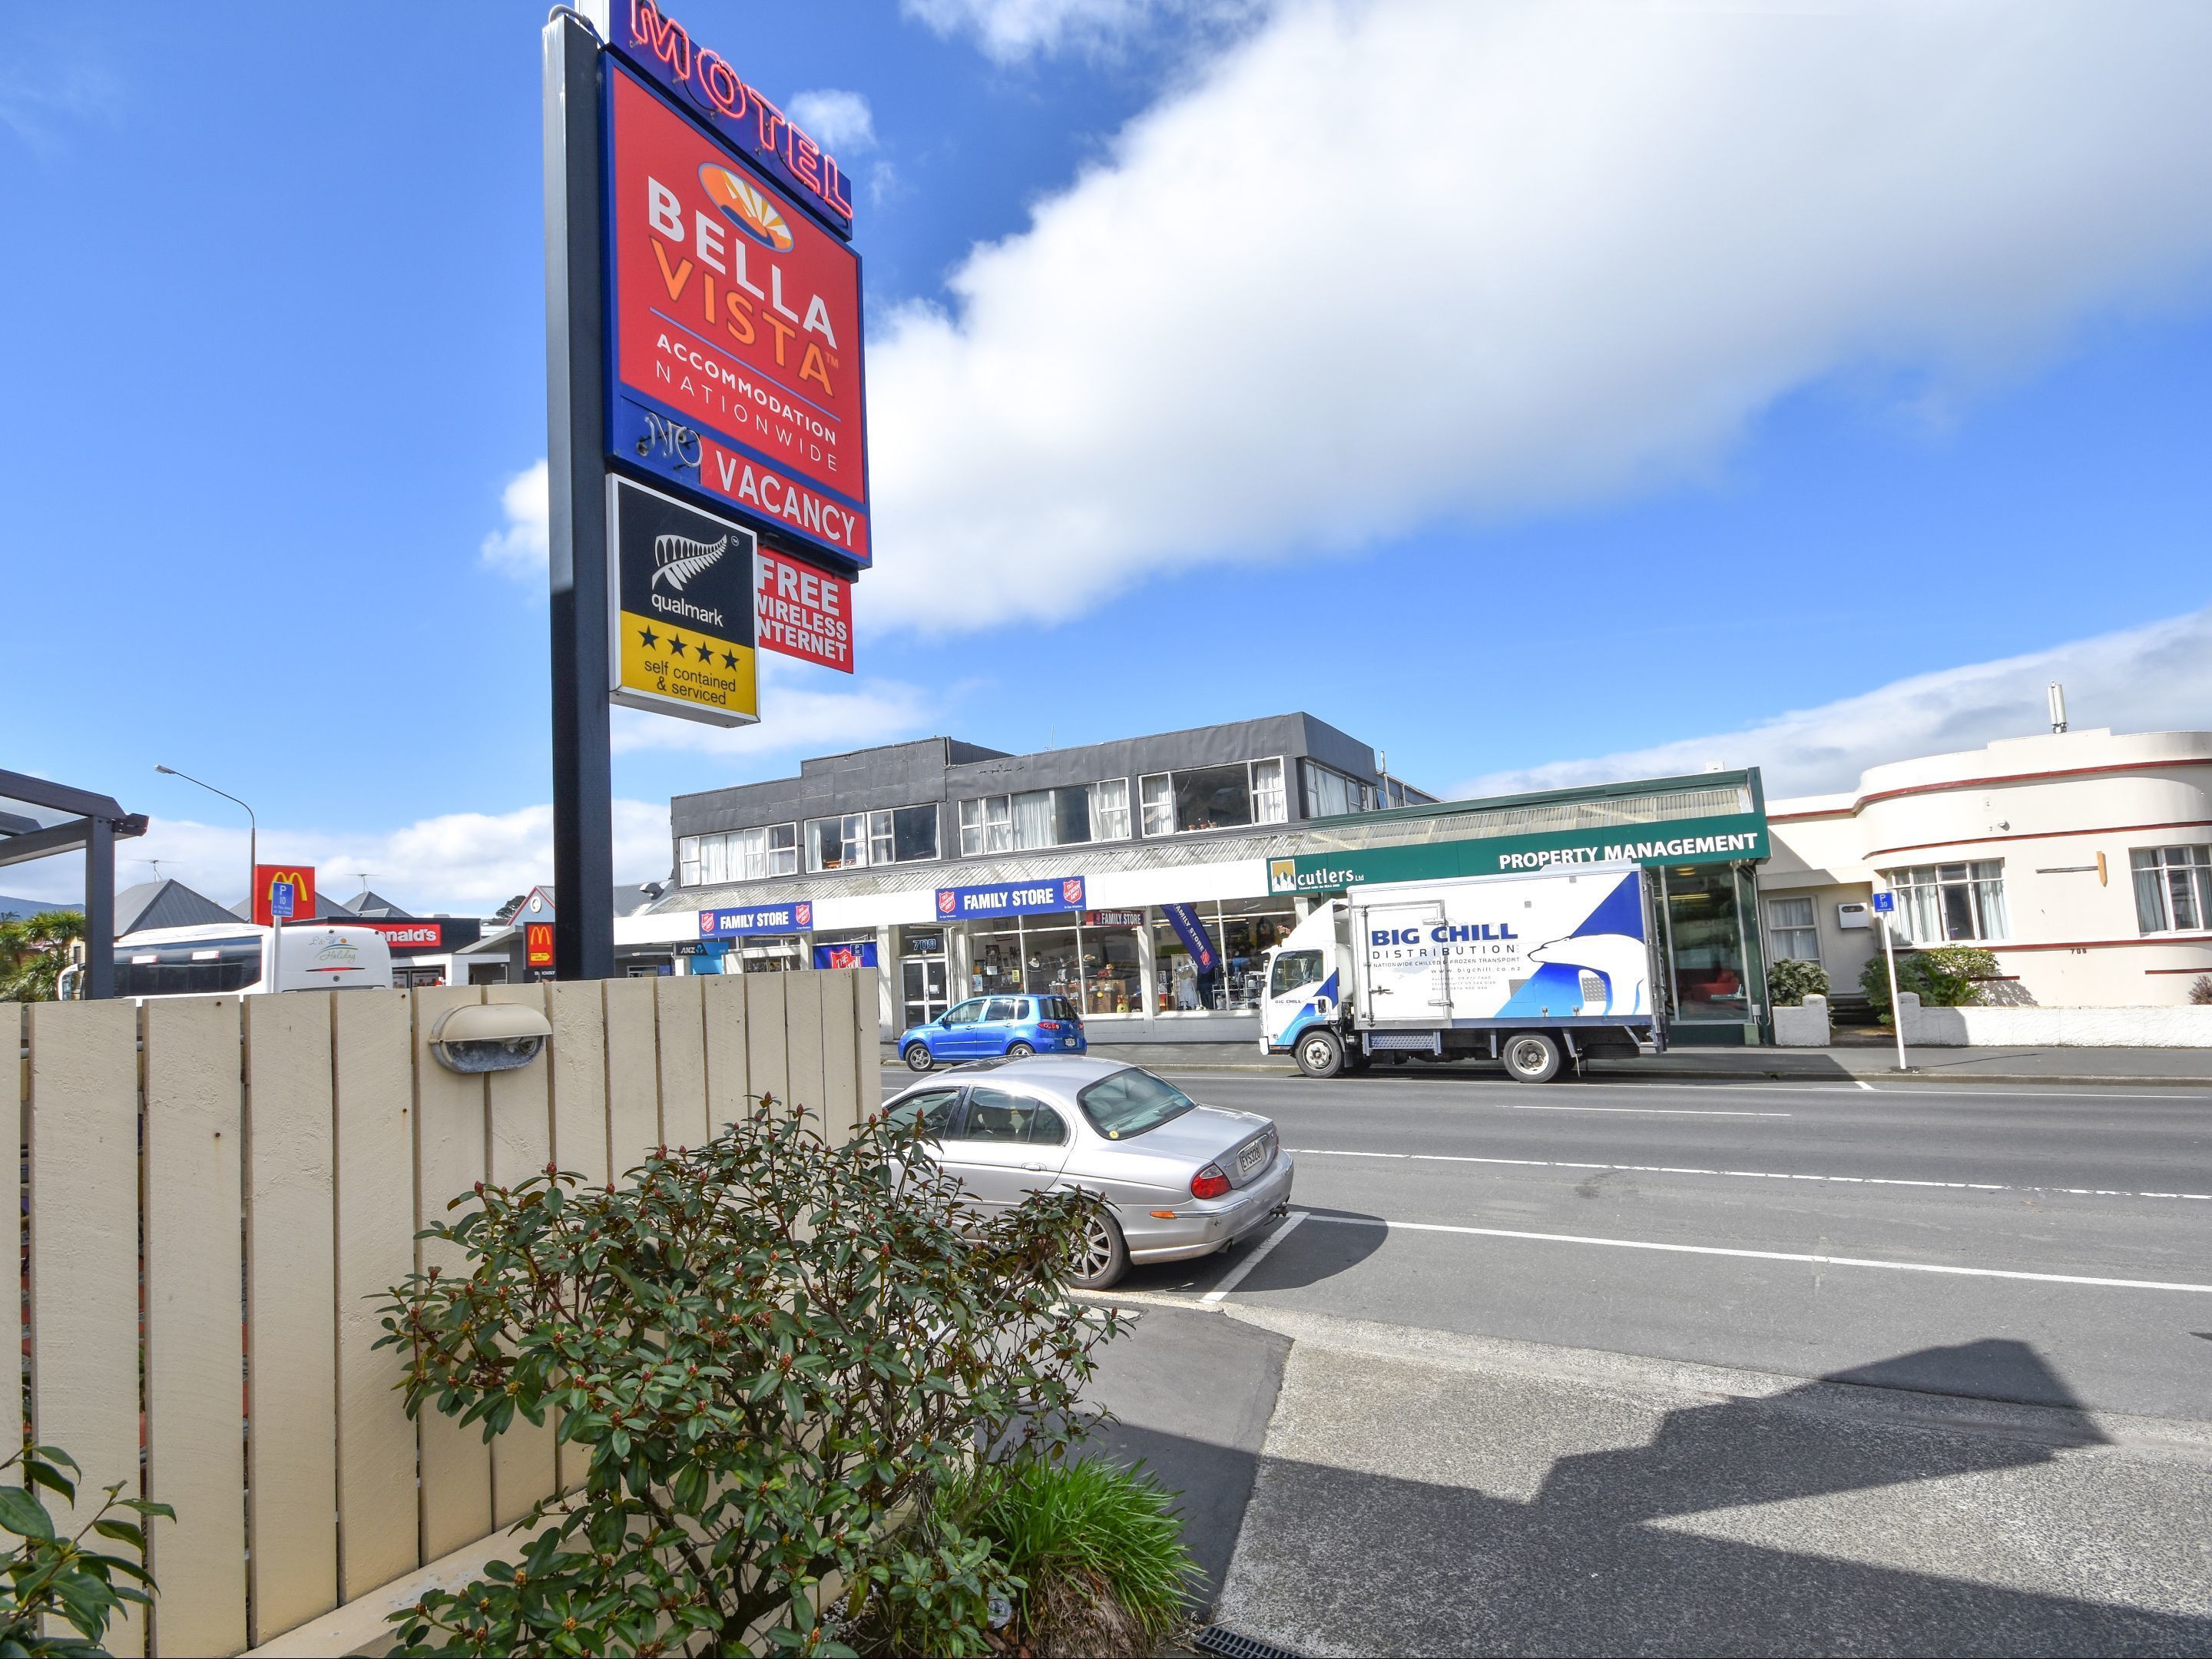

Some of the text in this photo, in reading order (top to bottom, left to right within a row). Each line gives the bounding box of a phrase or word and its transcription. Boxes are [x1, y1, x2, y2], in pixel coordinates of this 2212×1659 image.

[630, 0, 853, 220] MOTEL
[647, 175, 838, 350] BELLA
[649, 235, 835, 398] VISTA
[657, 333, 836, 446] ACCOMMODATION
[656, 360, 837, 472] NATIONWIDE
[636, 412, 703, 467] NO
[716, 450, 856, 547] VACANCY
[757, 555, 839, 617] FREE
[651, 594, 724, 628] qualmark
[758, 616, 847, 662] NTERNET
[644, 661, 736, 692] self contained
[657, 676, 726, 705] & serviced
[1499, 833, 1758, 869] PROPERTY MANAGEMENT
[280, 885, 286, 896] P
[1297, 868, 1354, 886] cutlers
[280, 896, 286, 905] 10
[964, 888, 1055, 910] FAMILY STORE
[720, 912, 789, 930] FAMILY STORE
[1101, 912, 1141, 926] FAMILY STORE
[1174, 903, 1191, 927] FAMILY
[912, 939, 936, 951] 709
[1189, 927, 1204, 952] STORE
[1372, 923, 1518, 946] BIG CHILL
[836, 954, 849, 968] THE
[1373, 945, 1515, 959] DISTRIBUTION
[1241, 1147, 1260, 1168] EYS328
